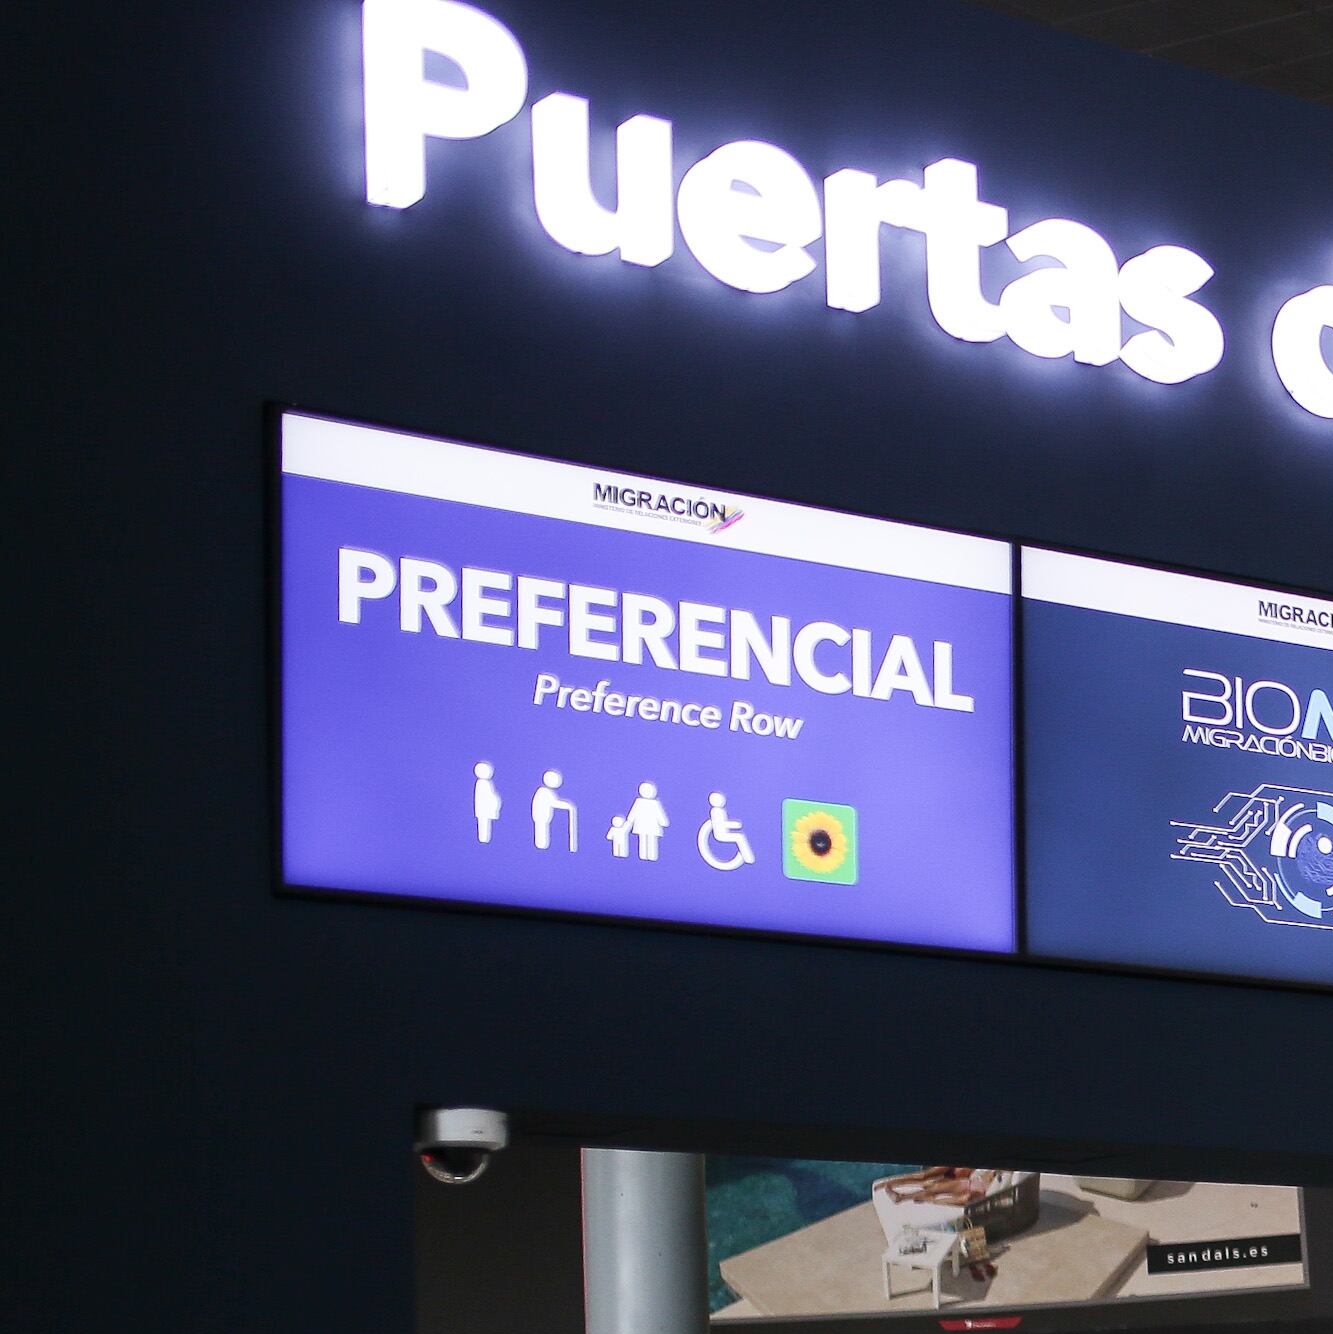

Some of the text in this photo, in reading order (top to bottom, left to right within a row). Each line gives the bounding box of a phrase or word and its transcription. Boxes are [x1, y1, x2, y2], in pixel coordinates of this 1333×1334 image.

[361, 0, 1224, 384] Puertas
[593, 482, 726, 522] MIGRACIÓN
[338, 547, 974, 713] PREFERENCIAL
[532, 674, 804, 741] Preference Row
[1167, 1244, 1269, 1265] sandals.es
